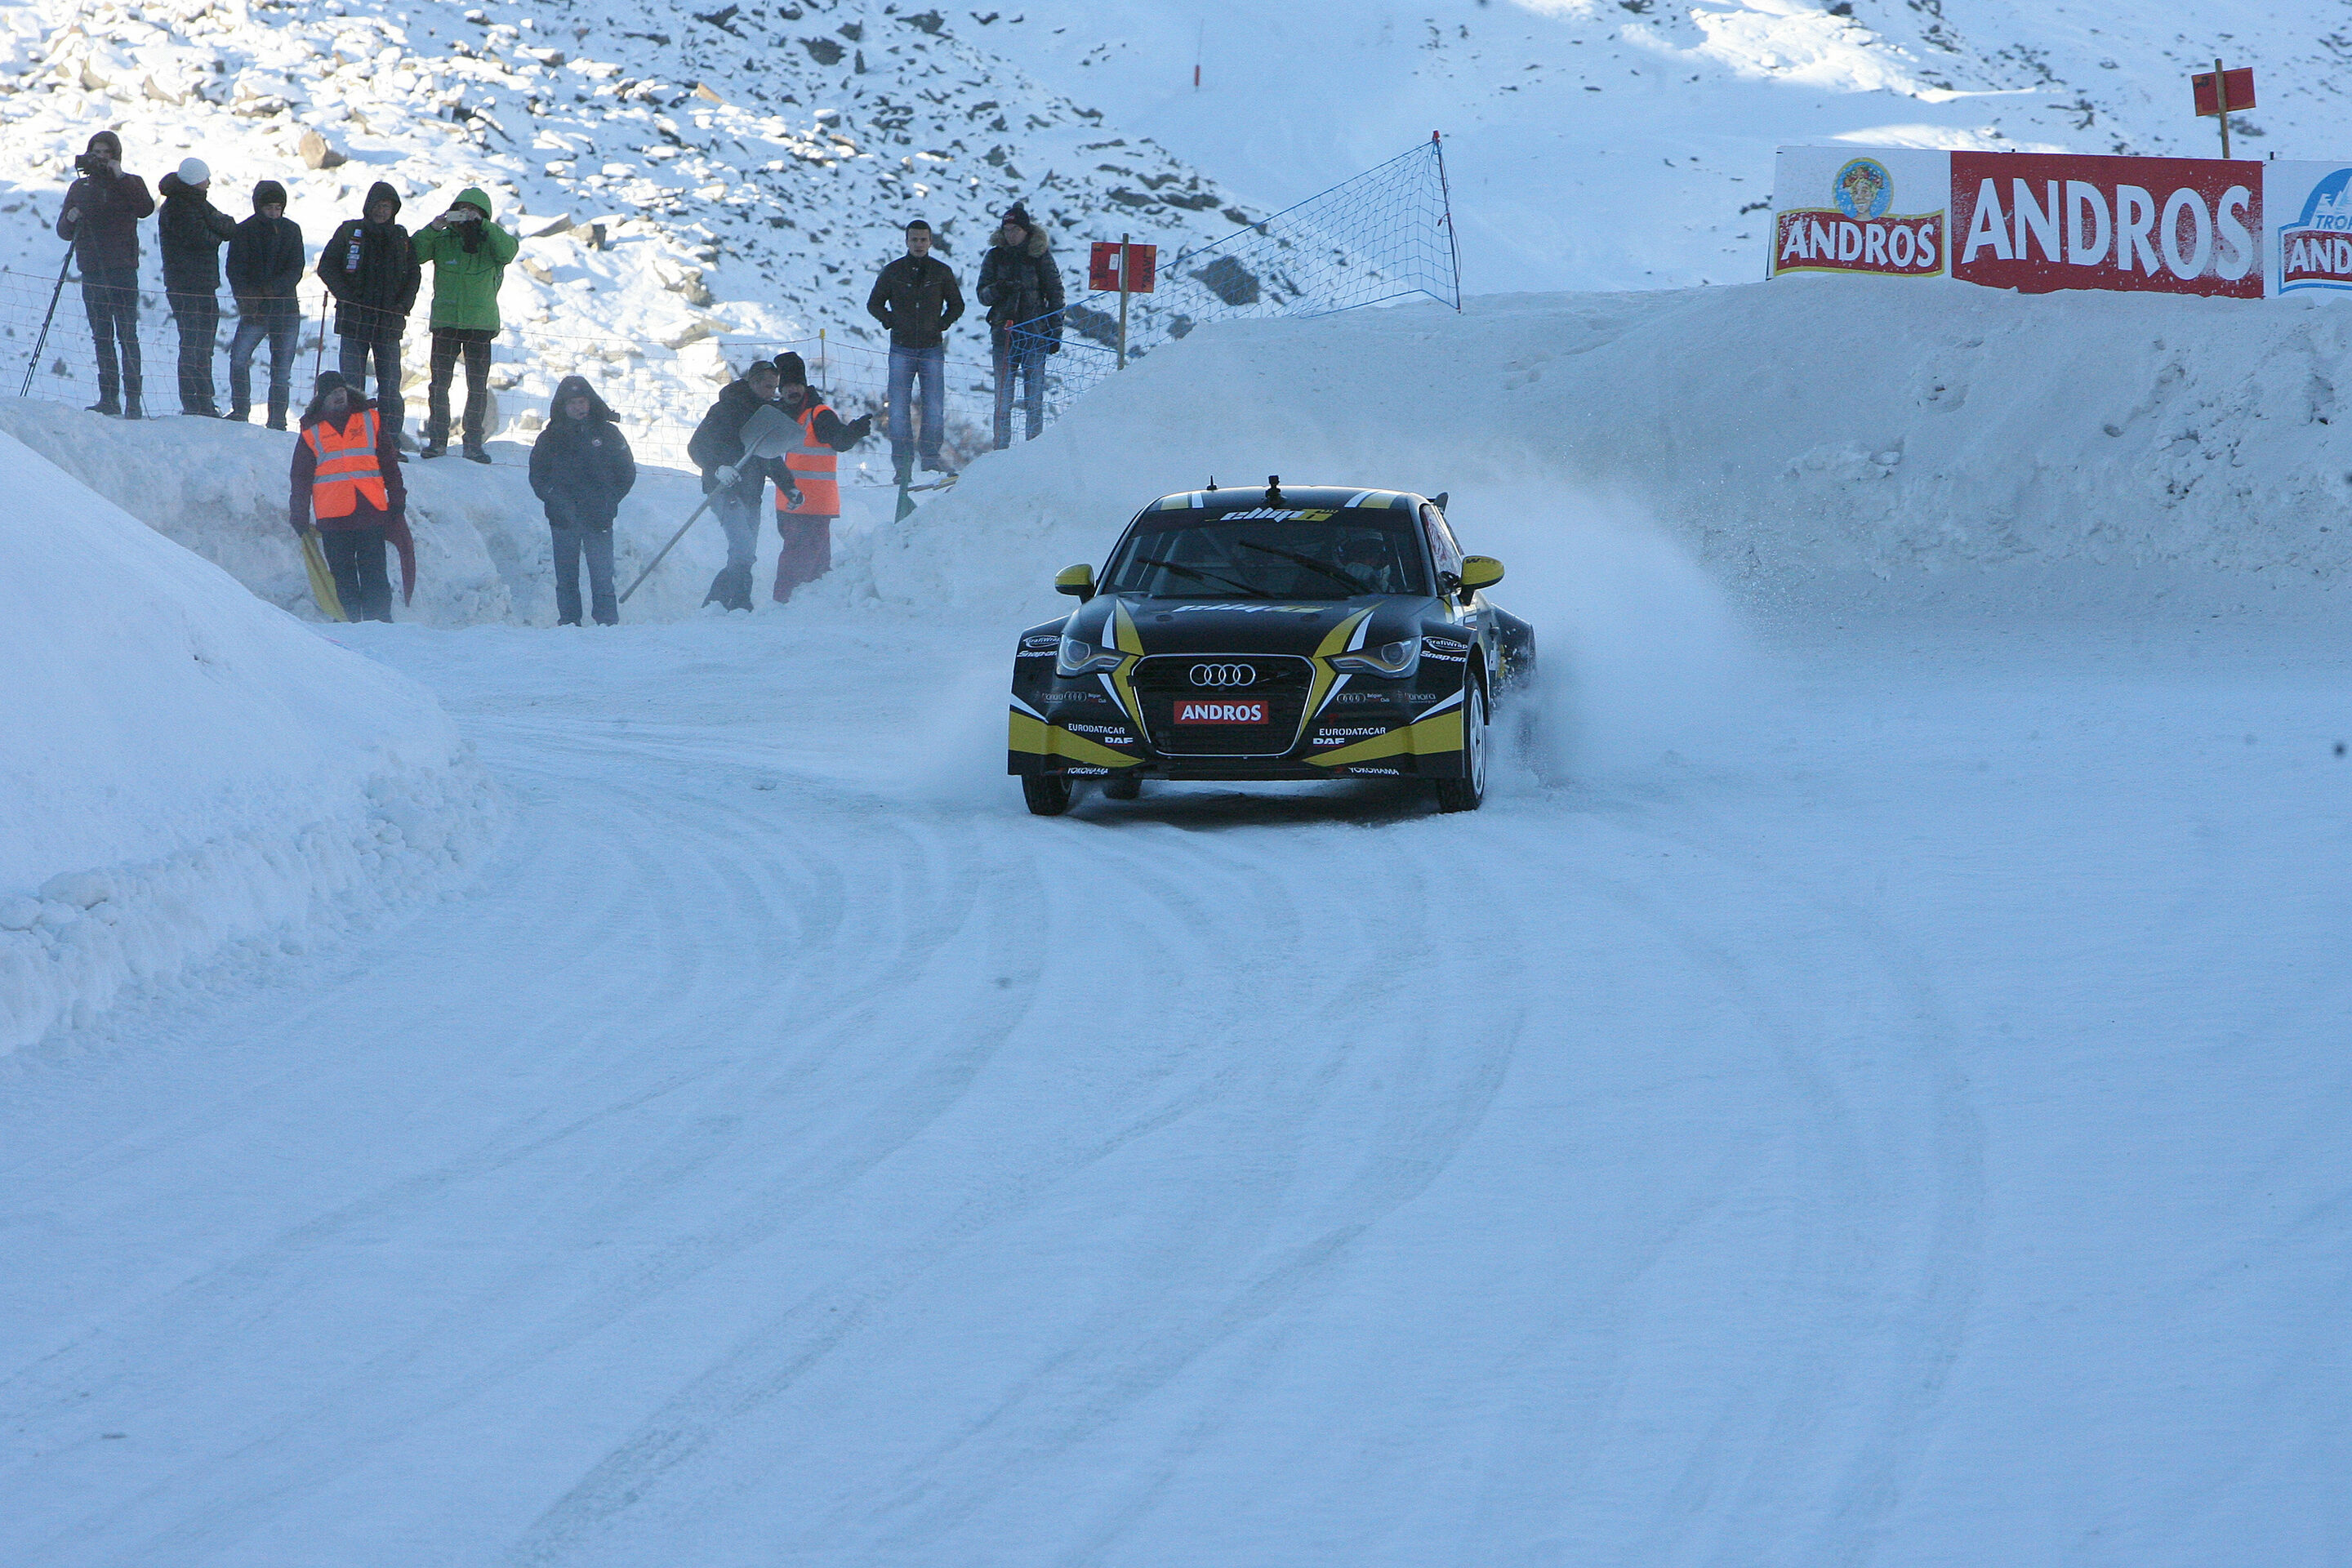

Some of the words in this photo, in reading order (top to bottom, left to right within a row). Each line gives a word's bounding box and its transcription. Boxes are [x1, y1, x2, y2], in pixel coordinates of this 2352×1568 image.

[1961, 177, 2254, 280] ANDROS
[1780, 219, 1936, 268] ANDROS
[1419, 650, 1467, 662] Snap-on
[1181, 704, 1262, 721] ANDROS
[1068, 723, 1125, 734] EURODATACAR
[1319, 727, 1386, 736] EURODATACAR
